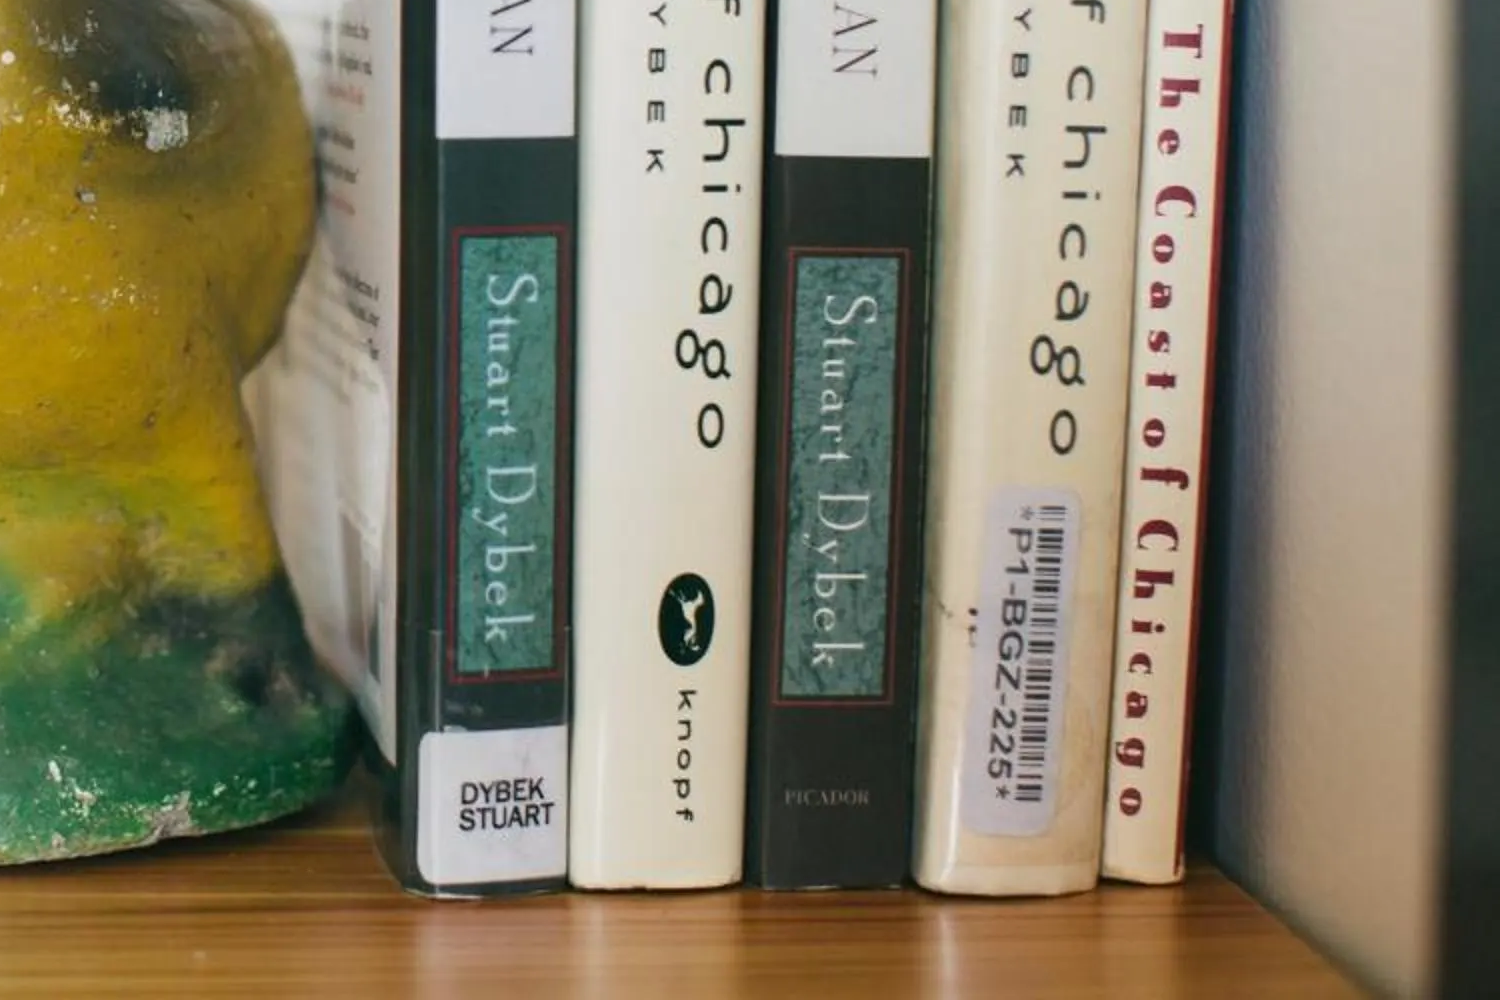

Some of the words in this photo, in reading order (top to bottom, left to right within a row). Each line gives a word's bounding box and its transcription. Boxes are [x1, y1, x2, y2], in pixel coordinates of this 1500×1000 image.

[1157, 24, 1203, 155] The
[675, 59, 746, 448] chicago
[1030, 65, 1107, 455] chicago
[1145, 185, 1197, 391] Coast
[485, 273, 540, 437] Stuart
[818, 295, 878, 463] Stuart
[1142, 418, 1190, 490] of
[471, 463, 538, 644] Dybek
[803, 493, 871, 669] Dybek
[1115, 519, 1180, 817] Chicago
[458, 802, 555, 831] STUART
[461, 777, 544, 805] DYBEK
[672, 689, 697, 823] knopf
[784, 789, 870, 806] PICADOR
